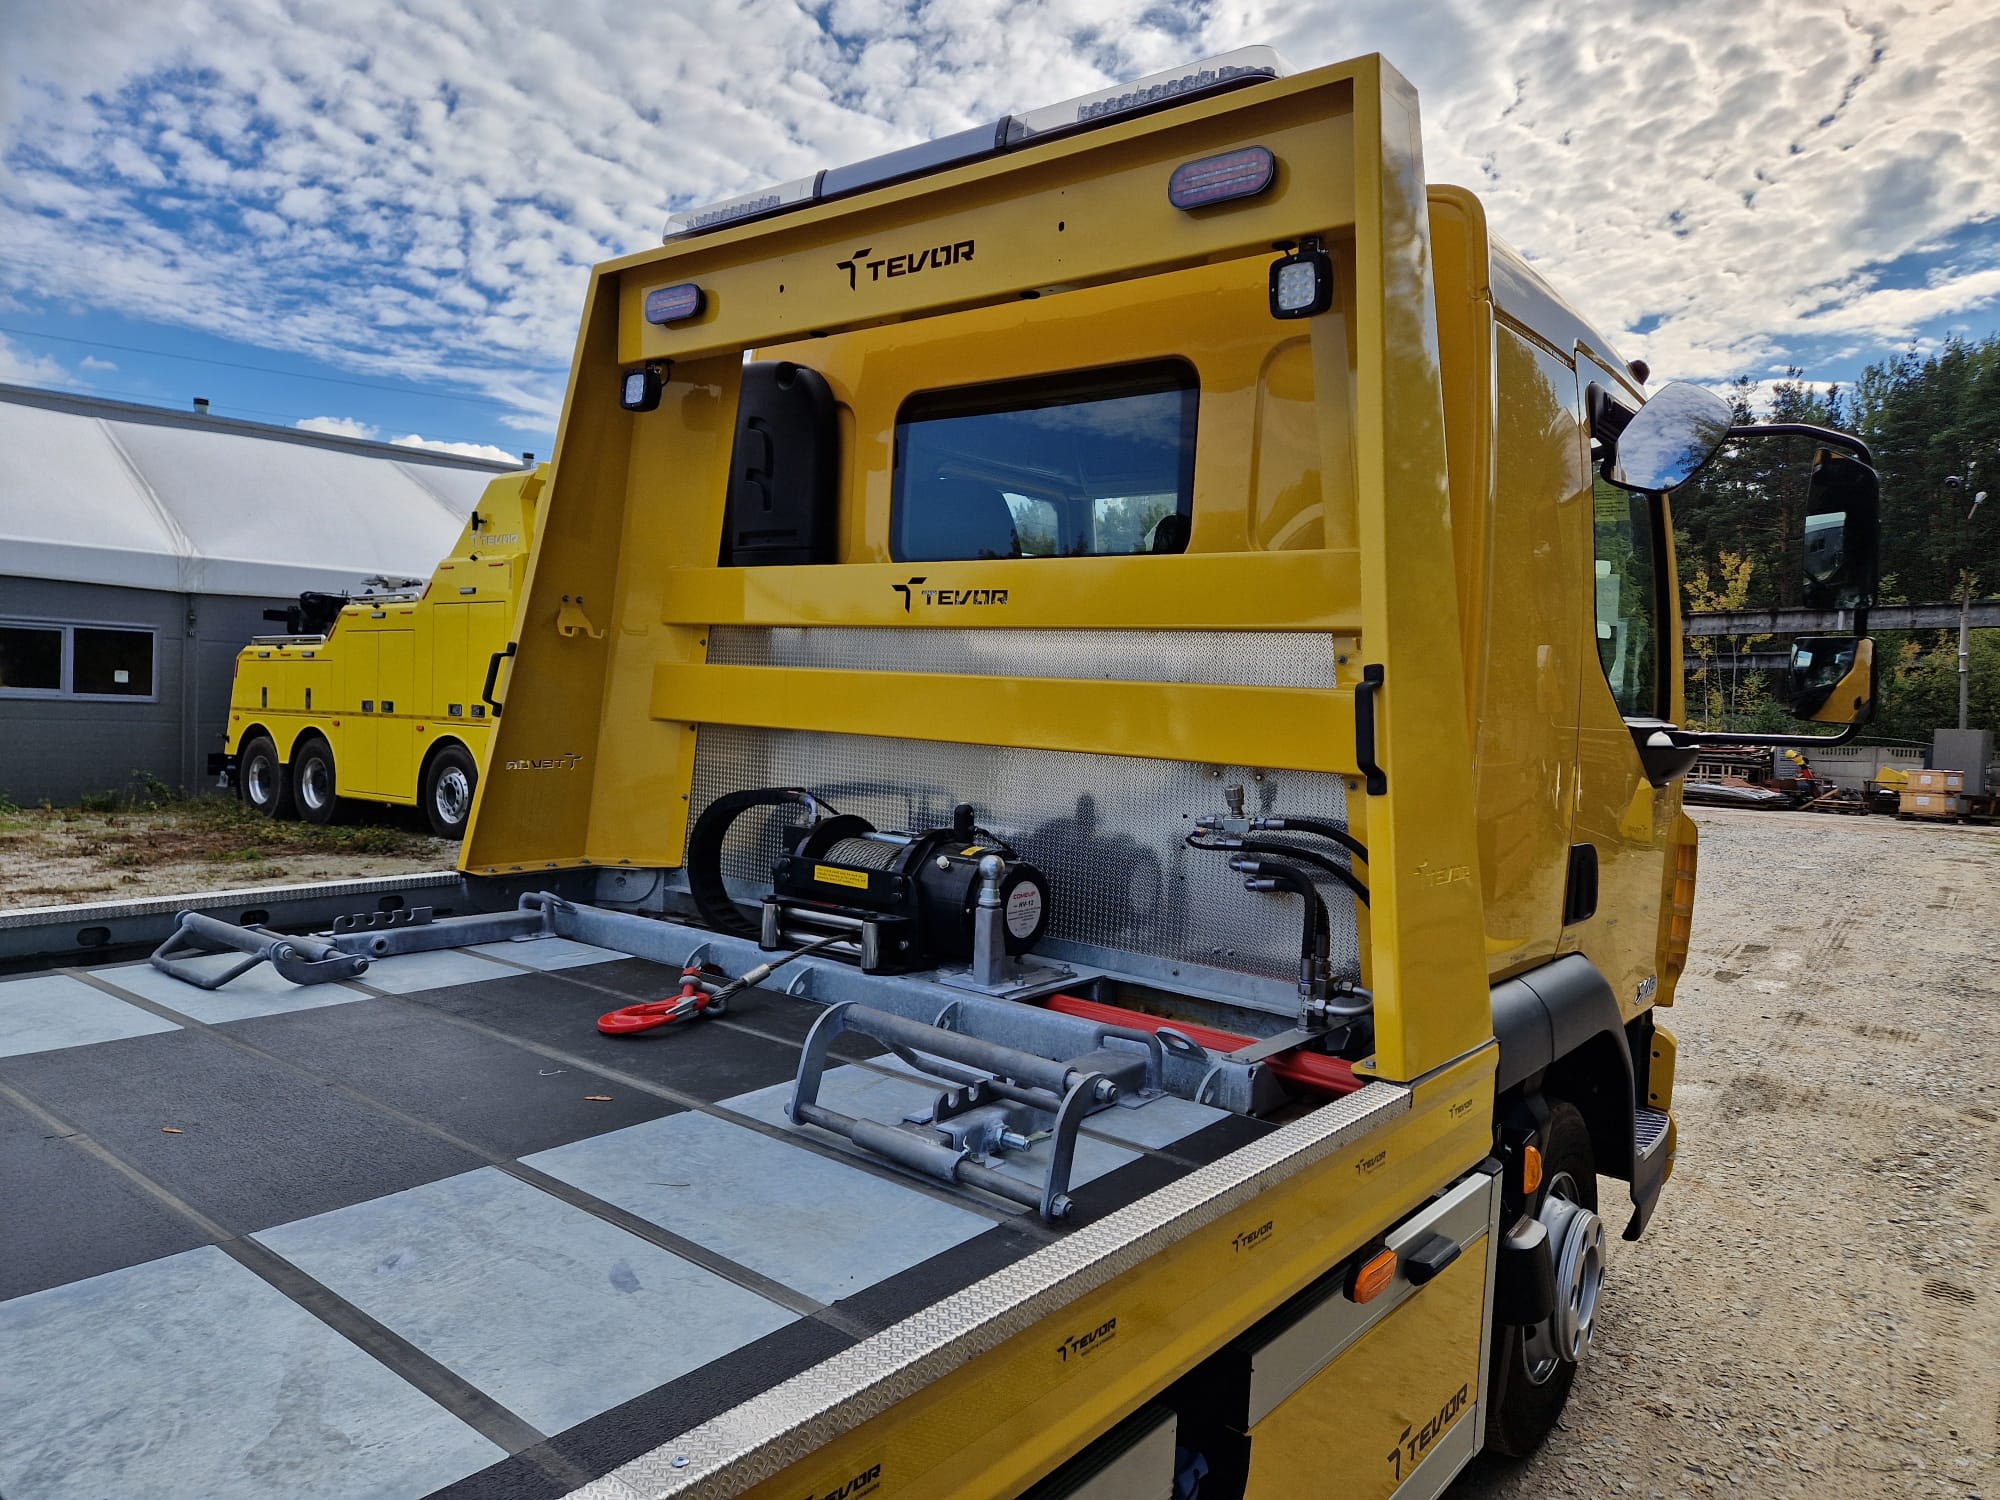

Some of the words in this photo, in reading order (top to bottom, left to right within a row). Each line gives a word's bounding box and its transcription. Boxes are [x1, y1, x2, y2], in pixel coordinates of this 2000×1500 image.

[866, 240, 975, 281] TEVOR
[921, 590, 1008, 605] TEVOR
[1241, 1221, 1272, 1246] TEVOR
[1071, 1317, 1116, 1353] TEVOR
[1407, 1383, 1467, 1461] TEVOR
